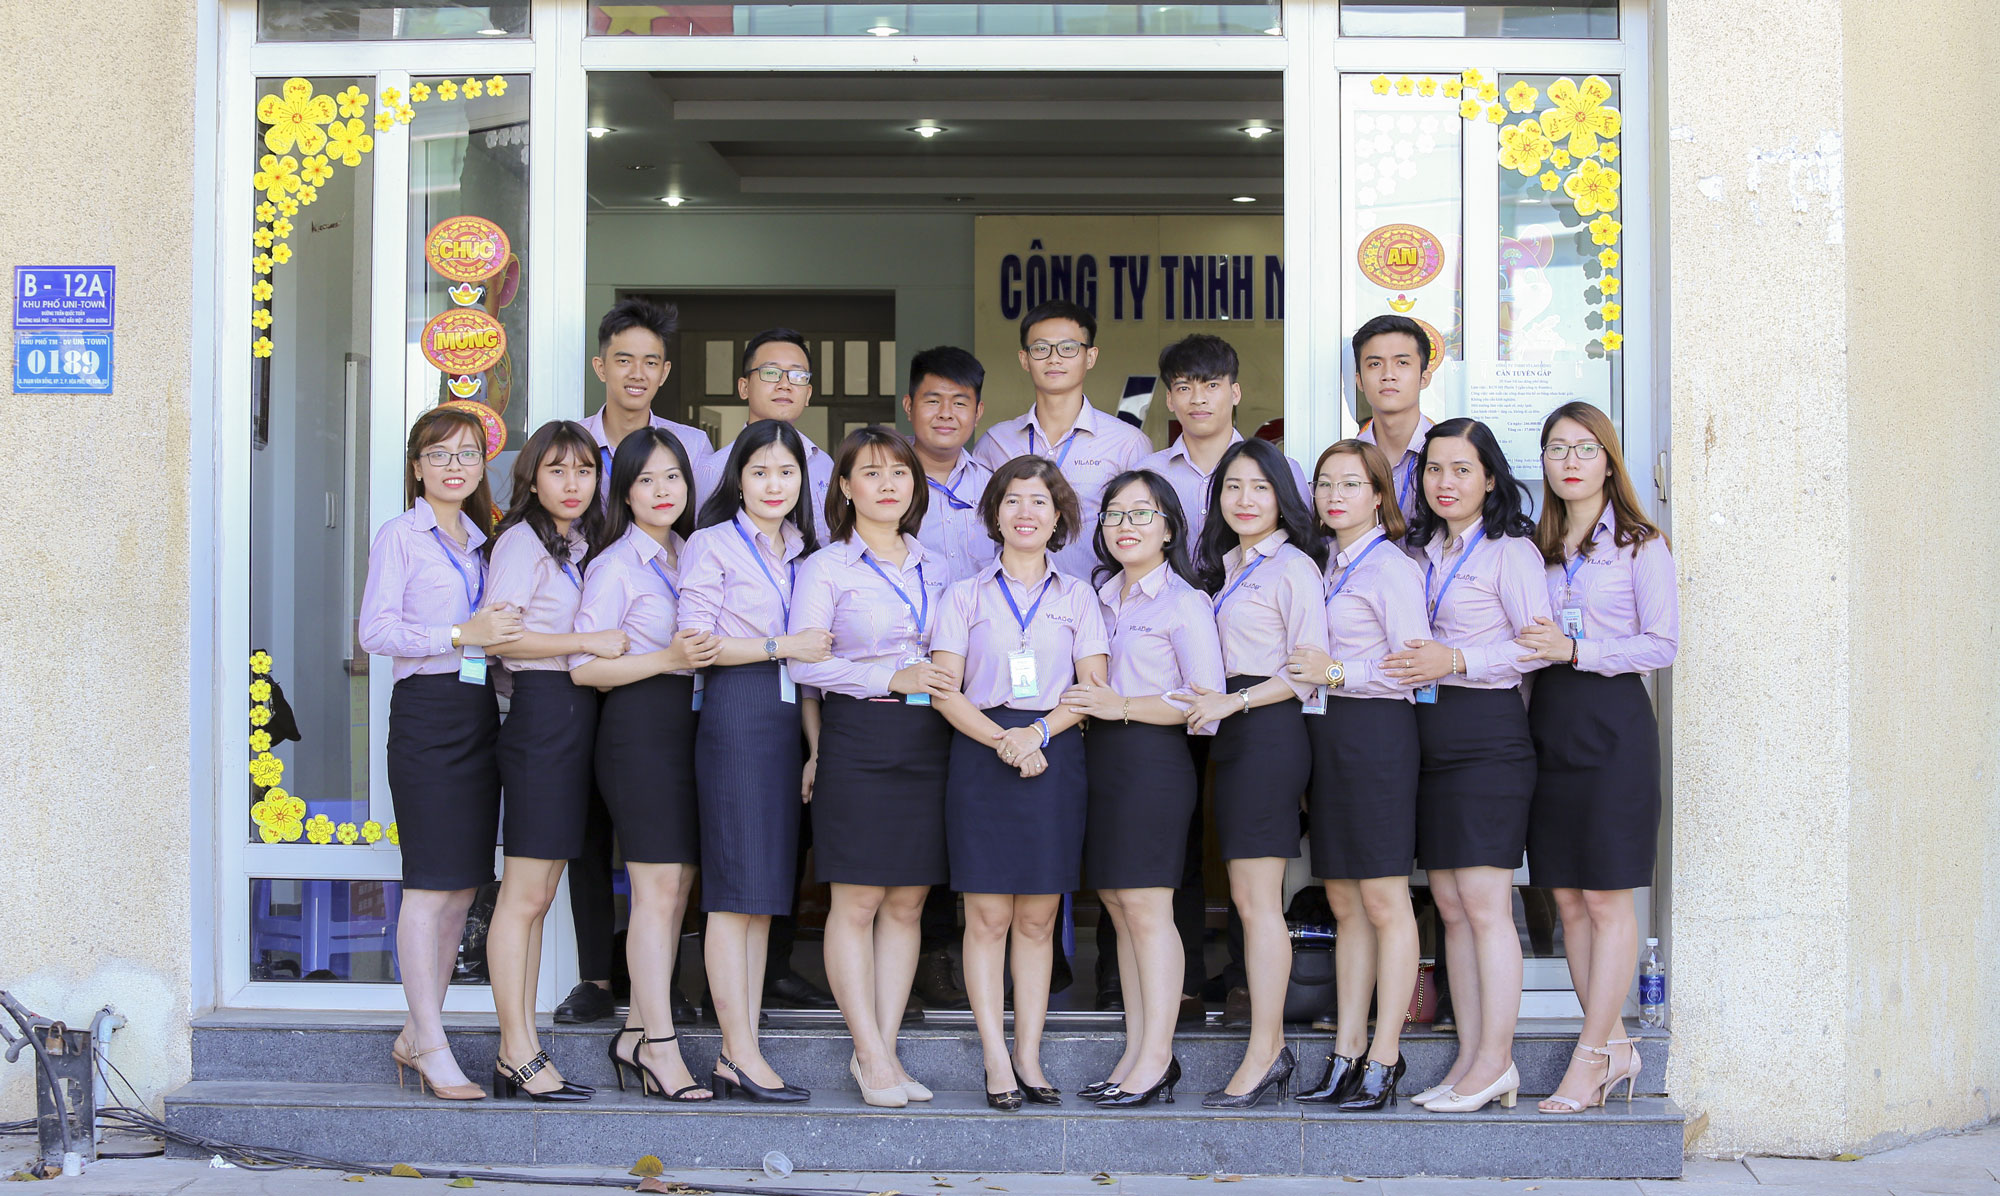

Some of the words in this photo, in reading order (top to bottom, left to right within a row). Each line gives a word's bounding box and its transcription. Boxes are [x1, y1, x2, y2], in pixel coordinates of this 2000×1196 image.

[439, 236, 494, 260] CHÚC
[1386, 247, 1418, 266] AN
[24, 273, 37, 297] B
[64, 273, 105, 297] 12A
[1001, 239, 1097, 320] CÔNG
[1109, 255, 1149, 320] TY
[1160, 254, 1254, 320] TNHH
[22, 300, 40, 309] KHU
[42, 297, 61, 309] PHỐ
[62, 300, 105, 309] UNI-TOWN
[27, 349, 100, 375] 0189
